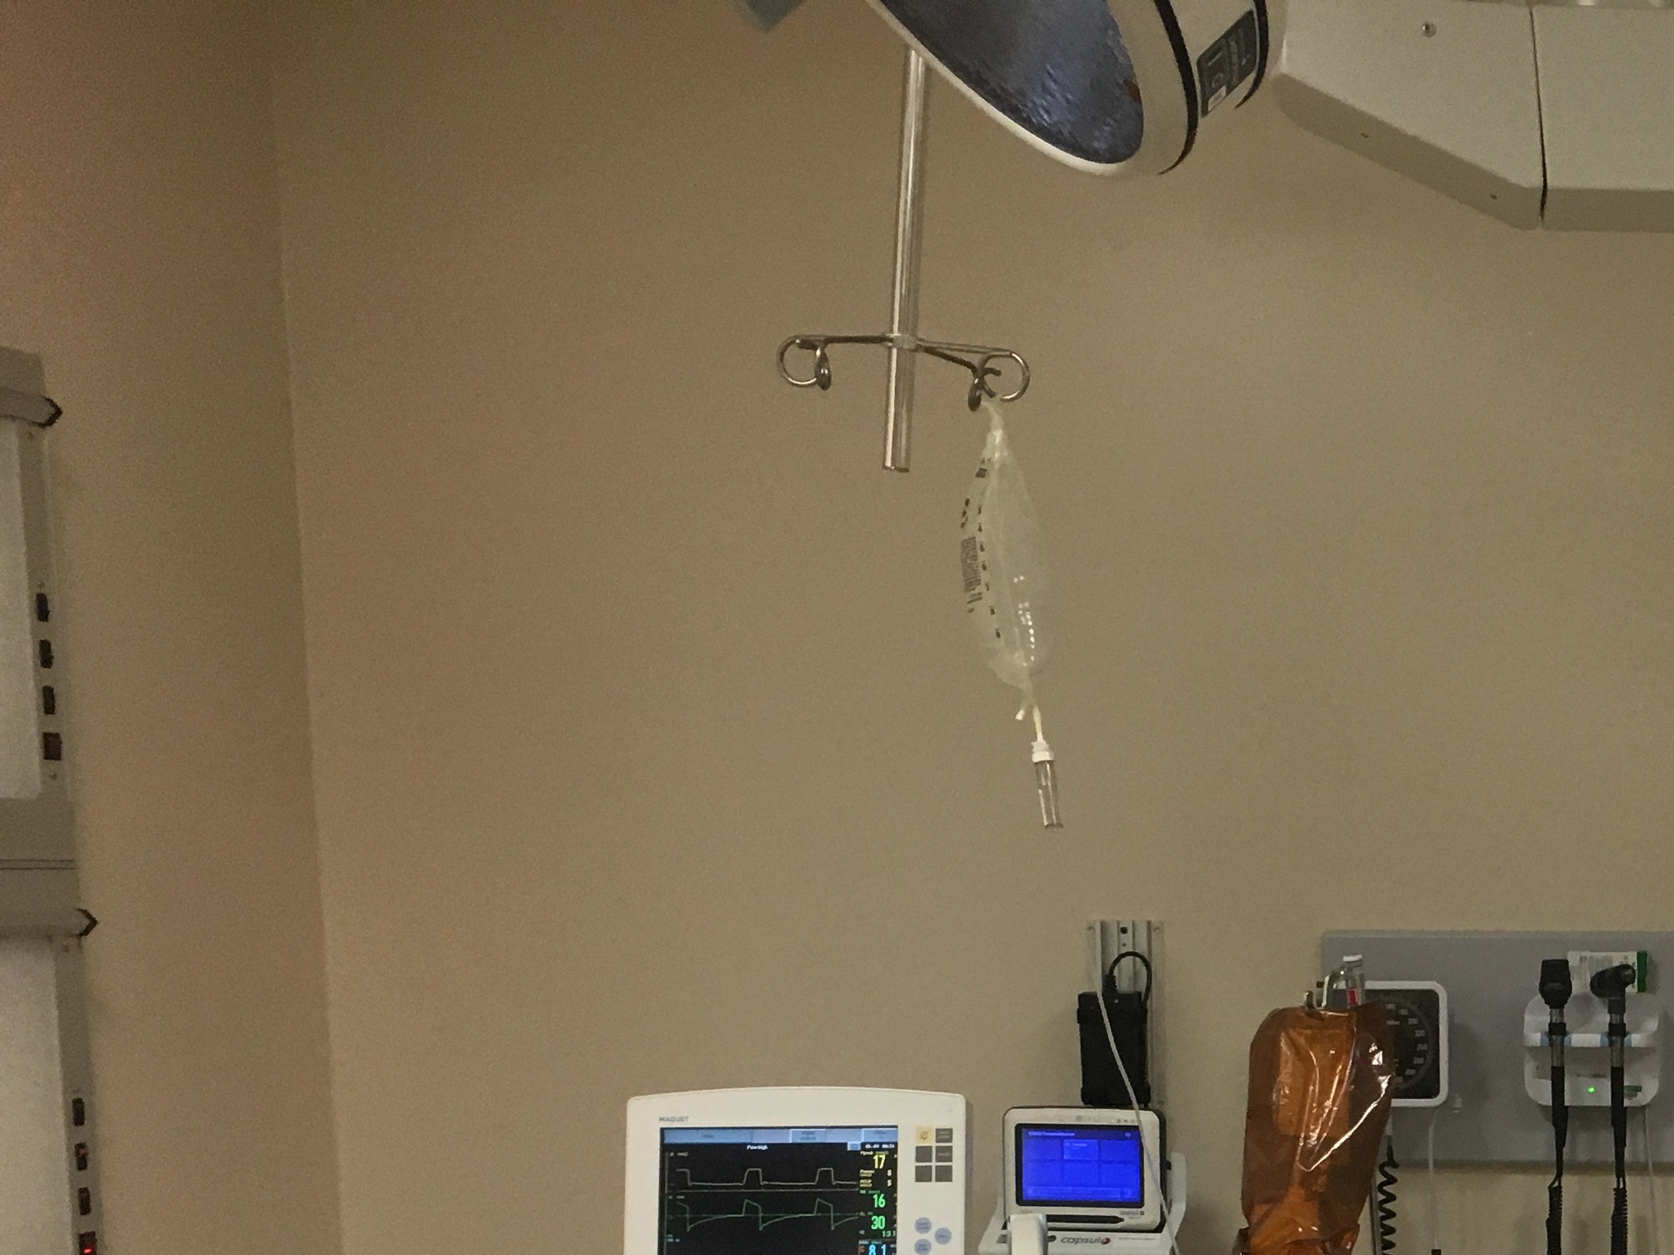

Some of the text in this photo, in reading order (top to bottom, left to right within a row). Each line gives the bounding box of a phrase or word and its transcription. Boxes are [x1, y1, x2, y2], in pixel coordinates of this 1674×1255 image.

[873, 1154, 886, 1169] 17
[873, 1193, 886, 1208] 16
[871, 1215, 885, 1230] 30
